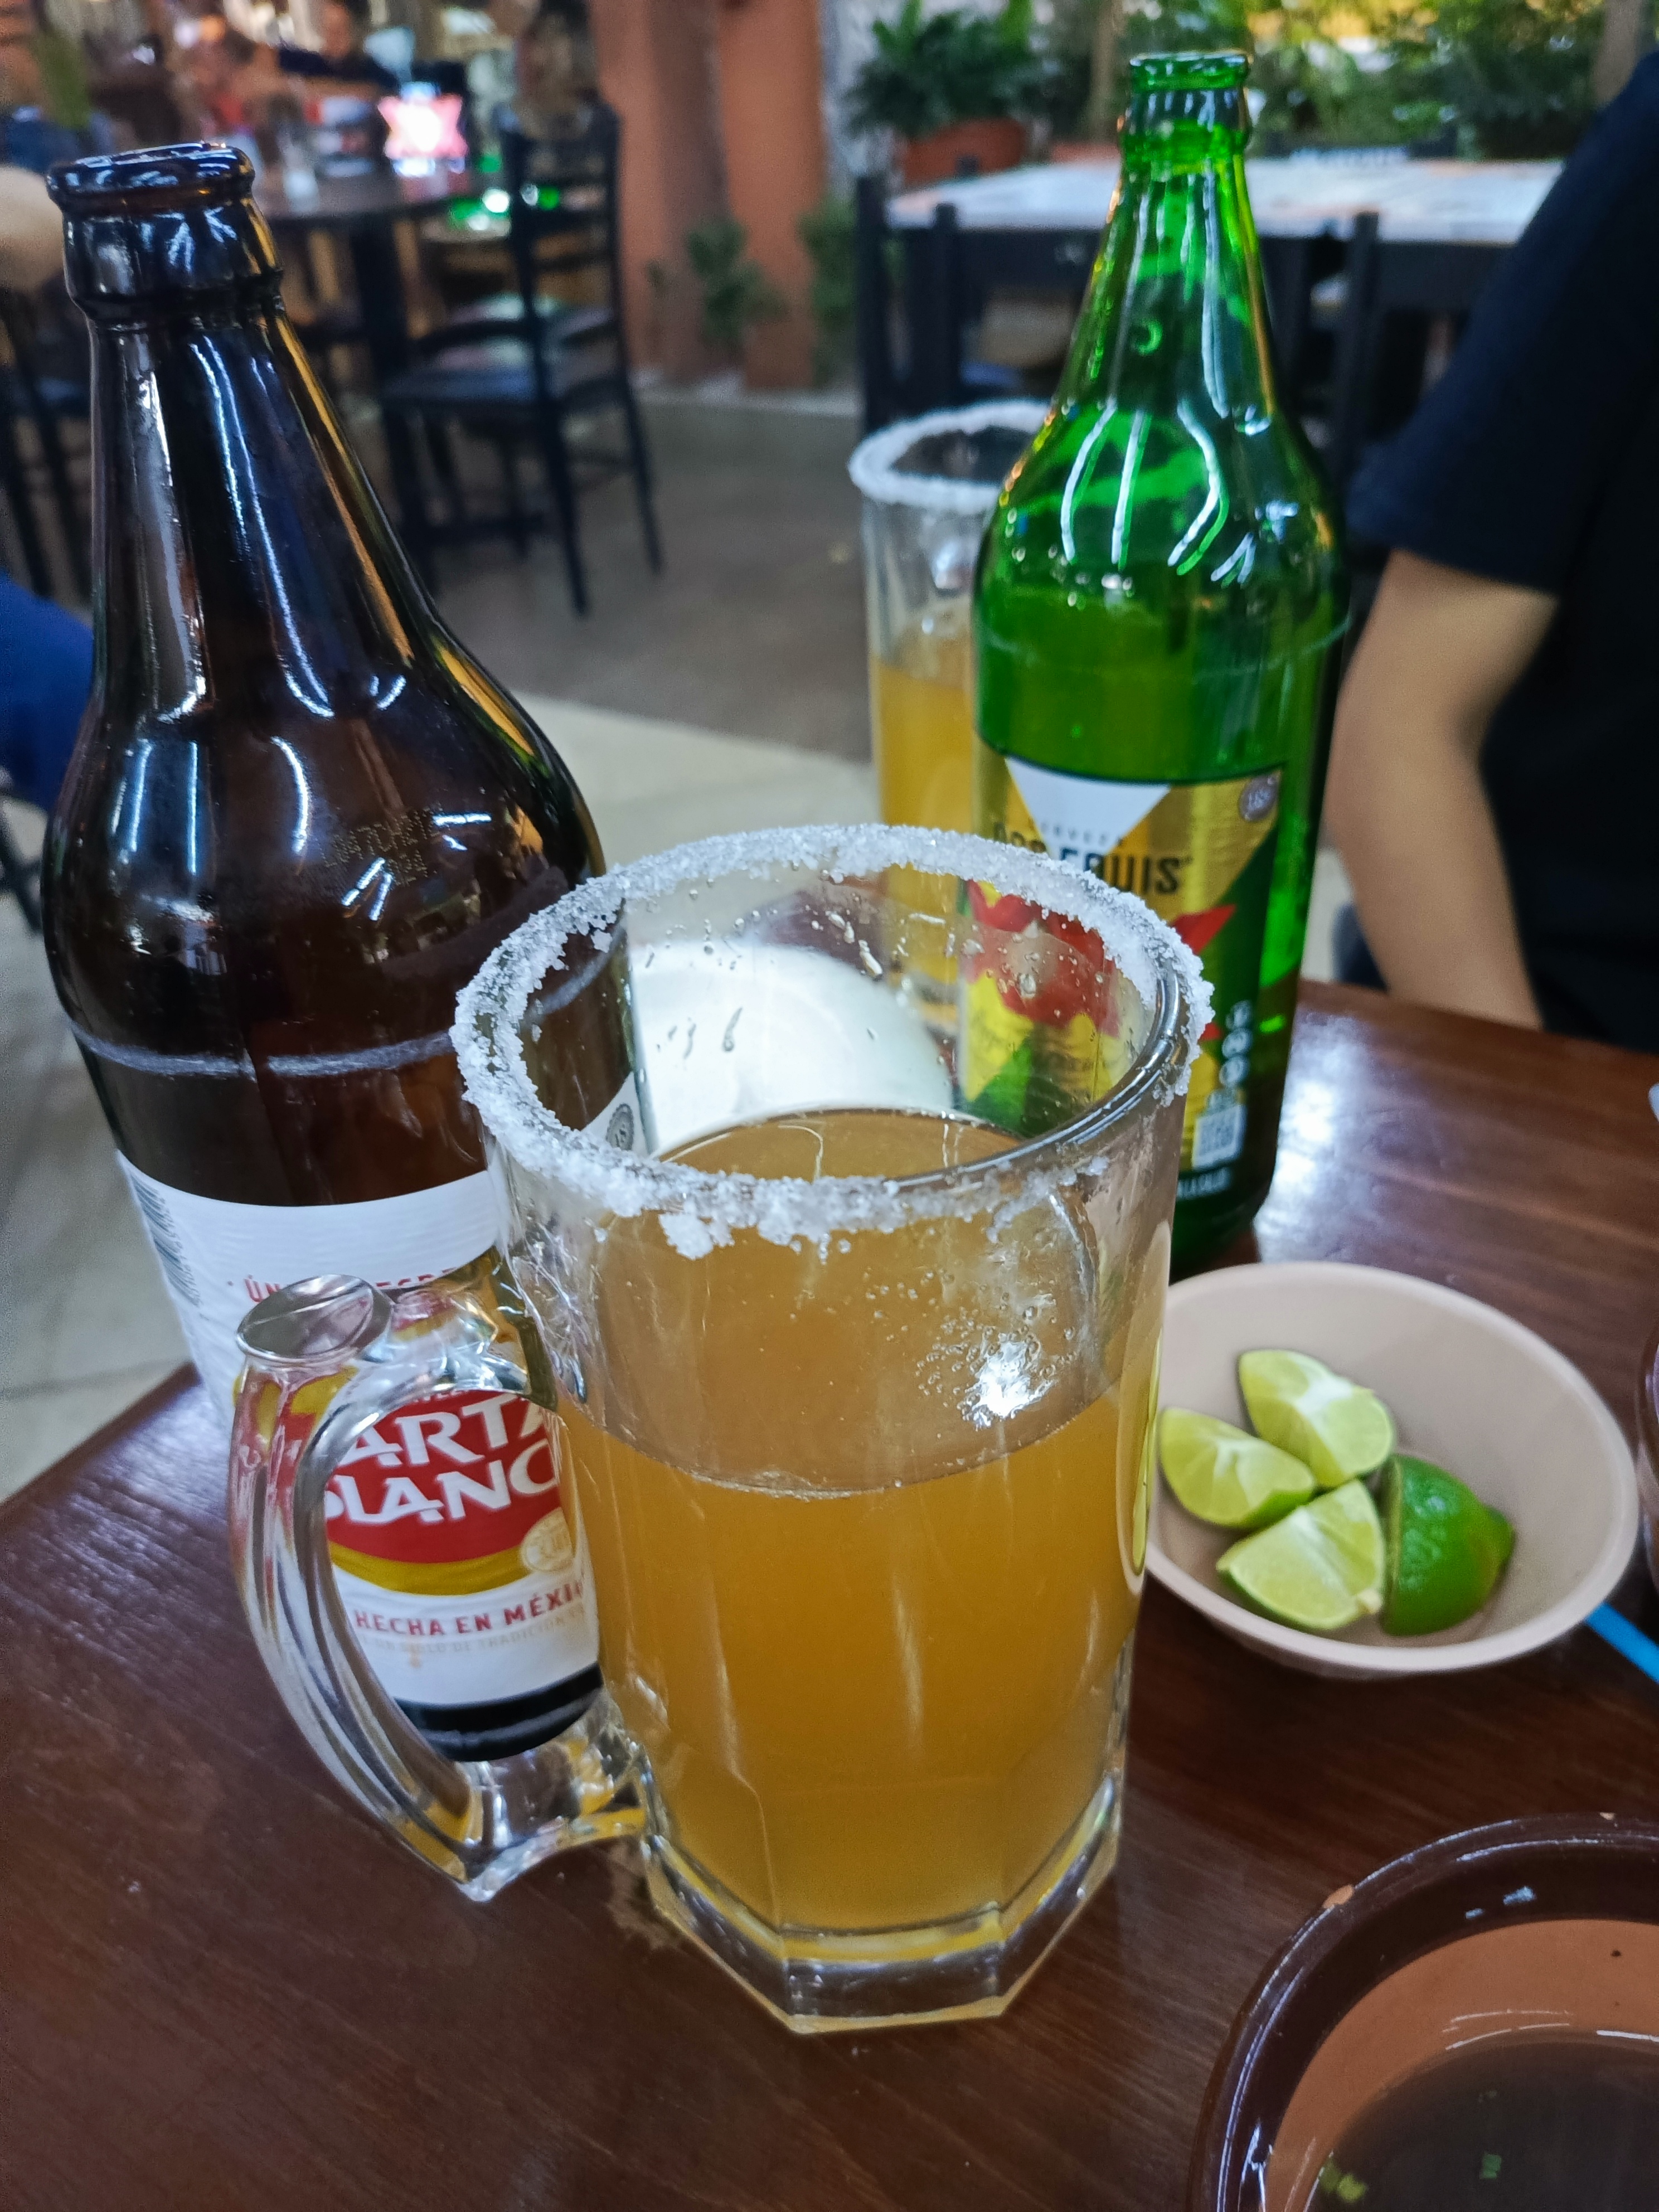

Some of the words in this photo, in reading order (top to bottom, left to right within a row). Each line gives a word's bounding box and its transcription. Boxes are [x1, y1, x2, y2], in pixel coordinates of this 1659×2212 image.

[337, 1394, 544, 1467] ART
[324, 1456, 558, 1525] LANC
[353, 1609, 444, 1636] HECHA
[455, 1613, 492, 1634] EN
